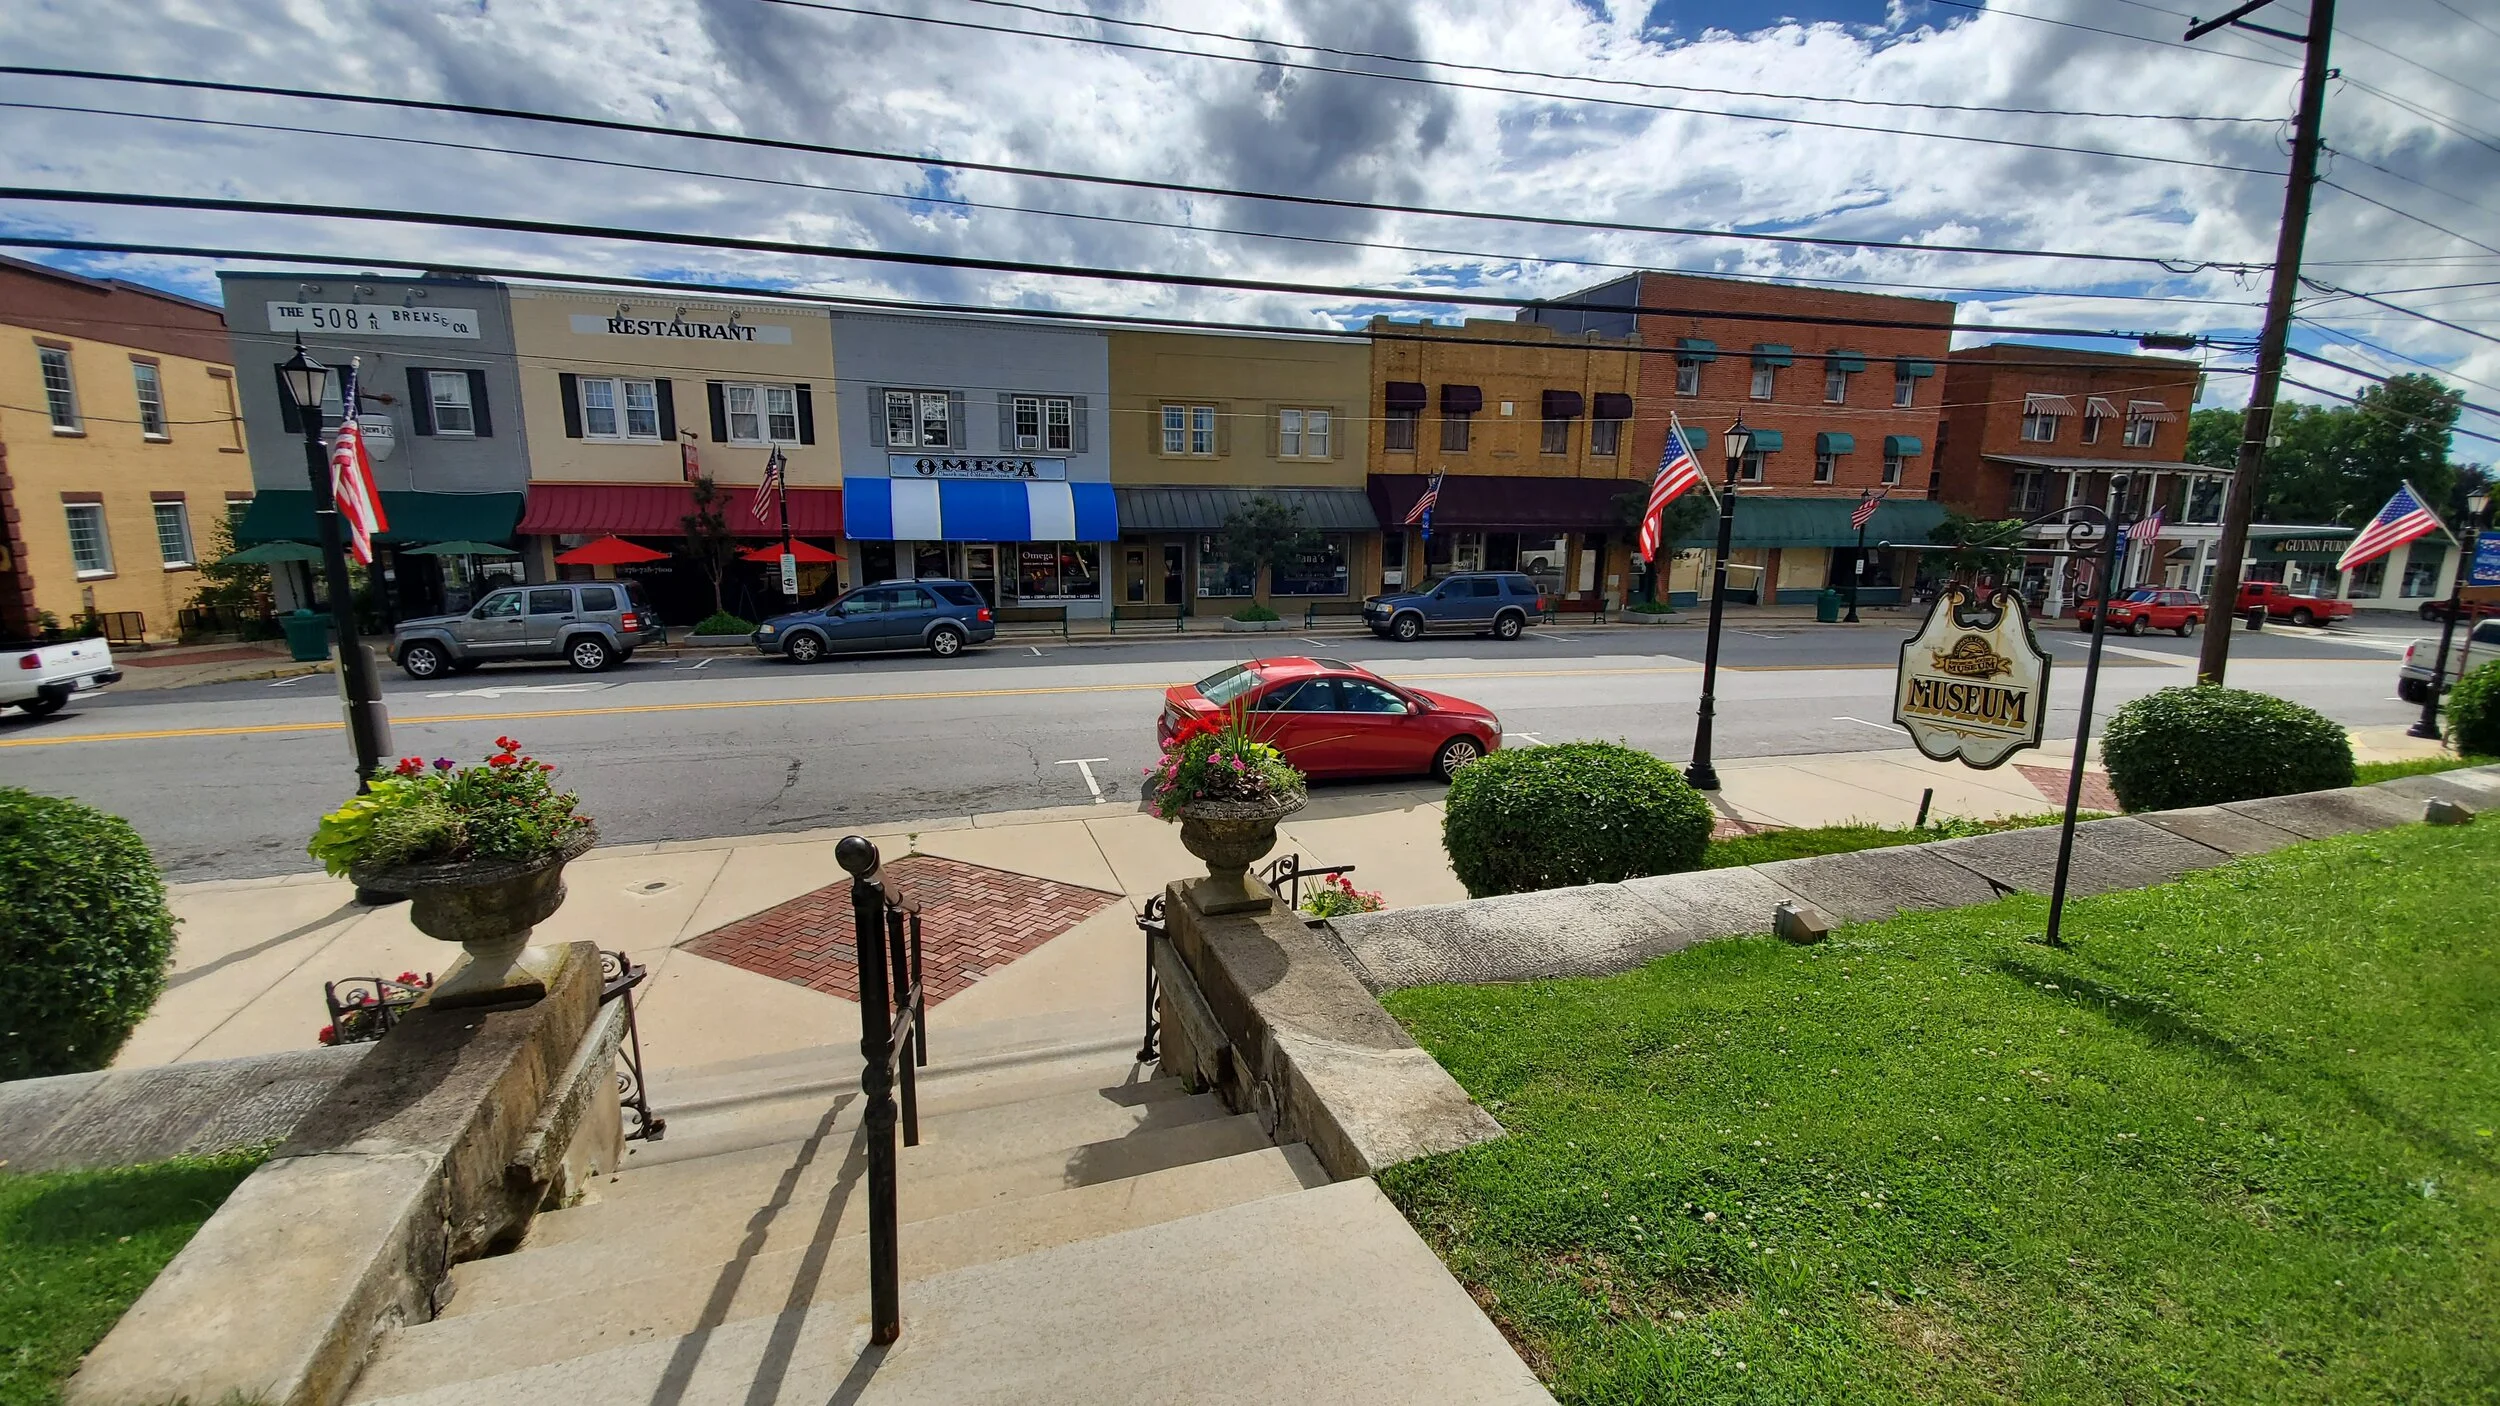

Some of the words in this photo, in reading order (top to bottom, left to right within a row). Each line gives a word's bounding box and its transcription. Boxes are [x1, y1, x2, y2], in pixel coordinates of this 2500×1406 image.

[278, 306, 304, 318] THE
[311, 308, 358, 330] 508
[392, 310, 440, 323] BREWS
[607, 318, 757, 341] RESTAURANT
[913, 458, 1039, 478] OMEGA
[1022, 551, 1054, 561] Omega
[2285, 539, 2321, 552] GUYNN
[1907, 678, 2029, 725] MUSEUM
